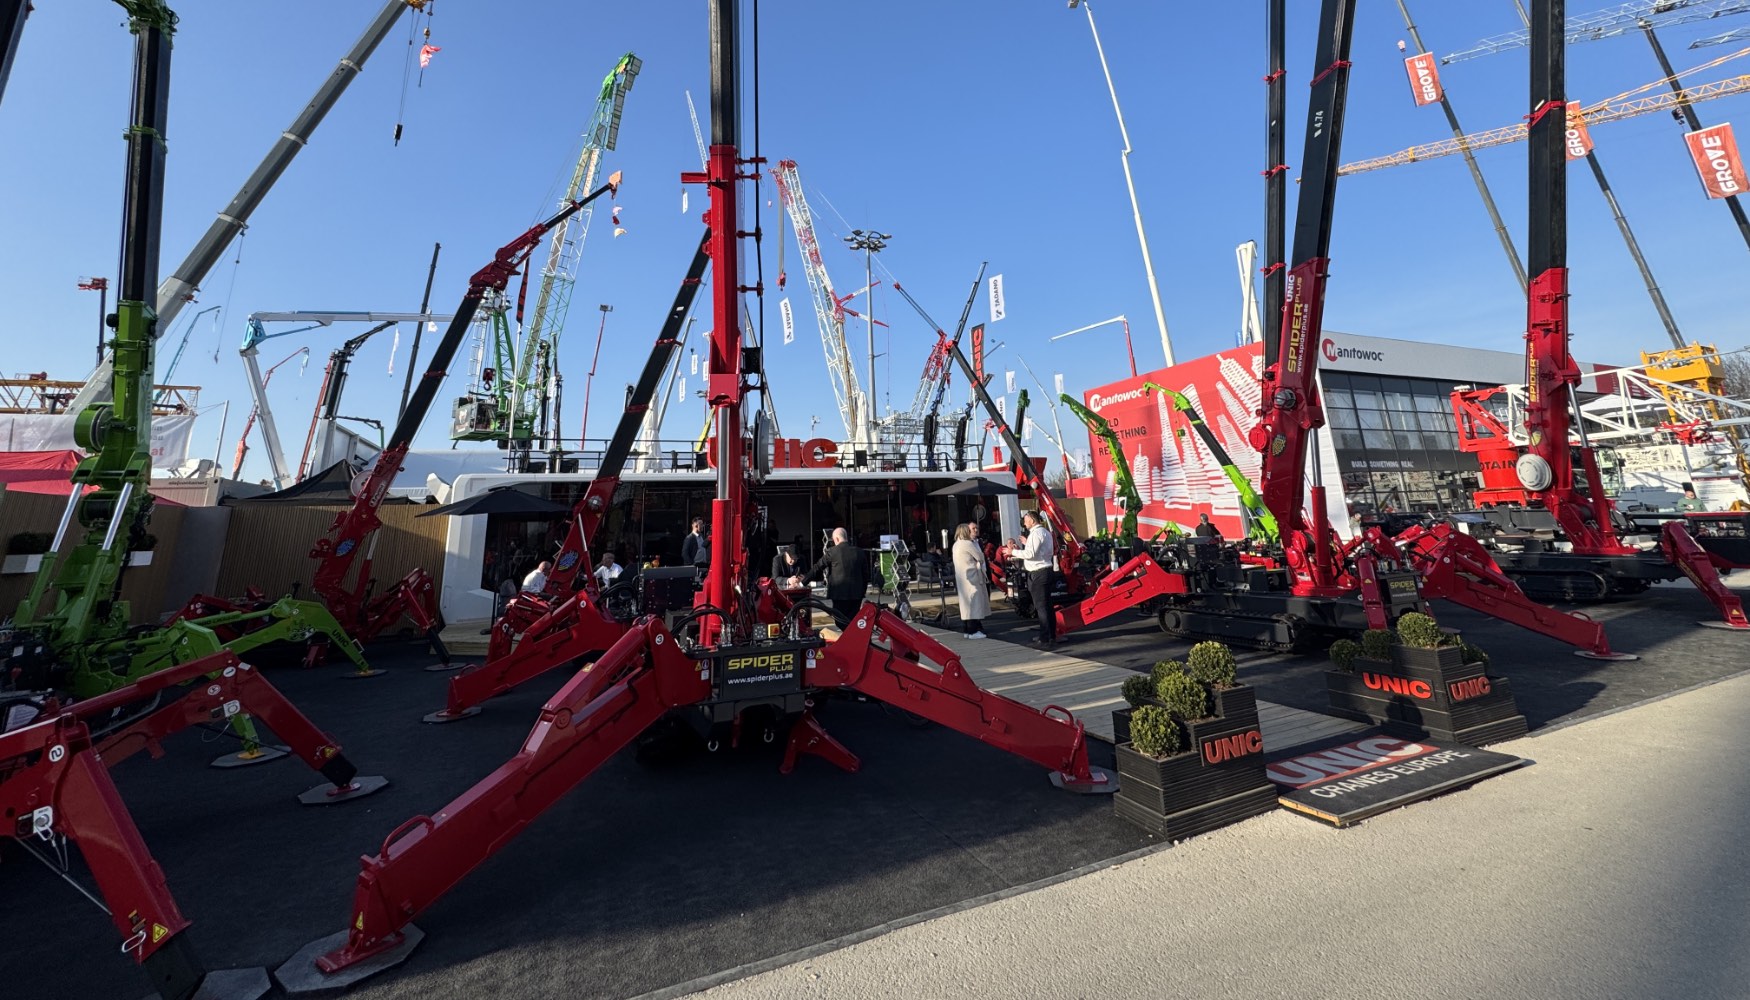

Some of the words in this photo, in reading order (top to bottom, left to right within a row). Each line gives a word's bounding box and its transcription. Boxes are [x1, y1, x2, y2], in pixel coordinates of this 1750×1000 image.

[1415, 59, 1437, 101] GROVE
[1314, 110, 1324, 128] 4.74
[1701, 135, 1740, 193] GROVE
[1286, 274, 1295, 302] UNIC
[1294, 277, 1303, 303] PLUS
[1287, 303, 1304, 373] SPIDER
[1297, 303, 1309, 373] www.spiderplus.ae
[1321, 338, 1383, 362] Manitowoc
[1529, 359, 1537, 402] SPIDER
[1090, 388, 1143, 412] Manitowoc
[1097, 426, 1147, 443] SETHING
[706, 437, 839, 468] IC
[1390, 580, 1416, 589] SPIDER
[332, 629, 349, 647] UNIC
[728, 653, 794, 670] SPIDER
[769, 664, 794, 673] PLUS
[727, 672, 794, 685] www.spiderplus.ae
[1362, 672, 1433, 699] UNIC
[1451, 676, 1492, 701] UNIC
[50, 747, 62, 760] 2
[1204, 730, 1263, 764] UNIC
[1266, 737, 1424, 784] UNIC
[1309, 771, 1394, 798] CRANES
[1388, 750, 1472, 776] EUROPE
